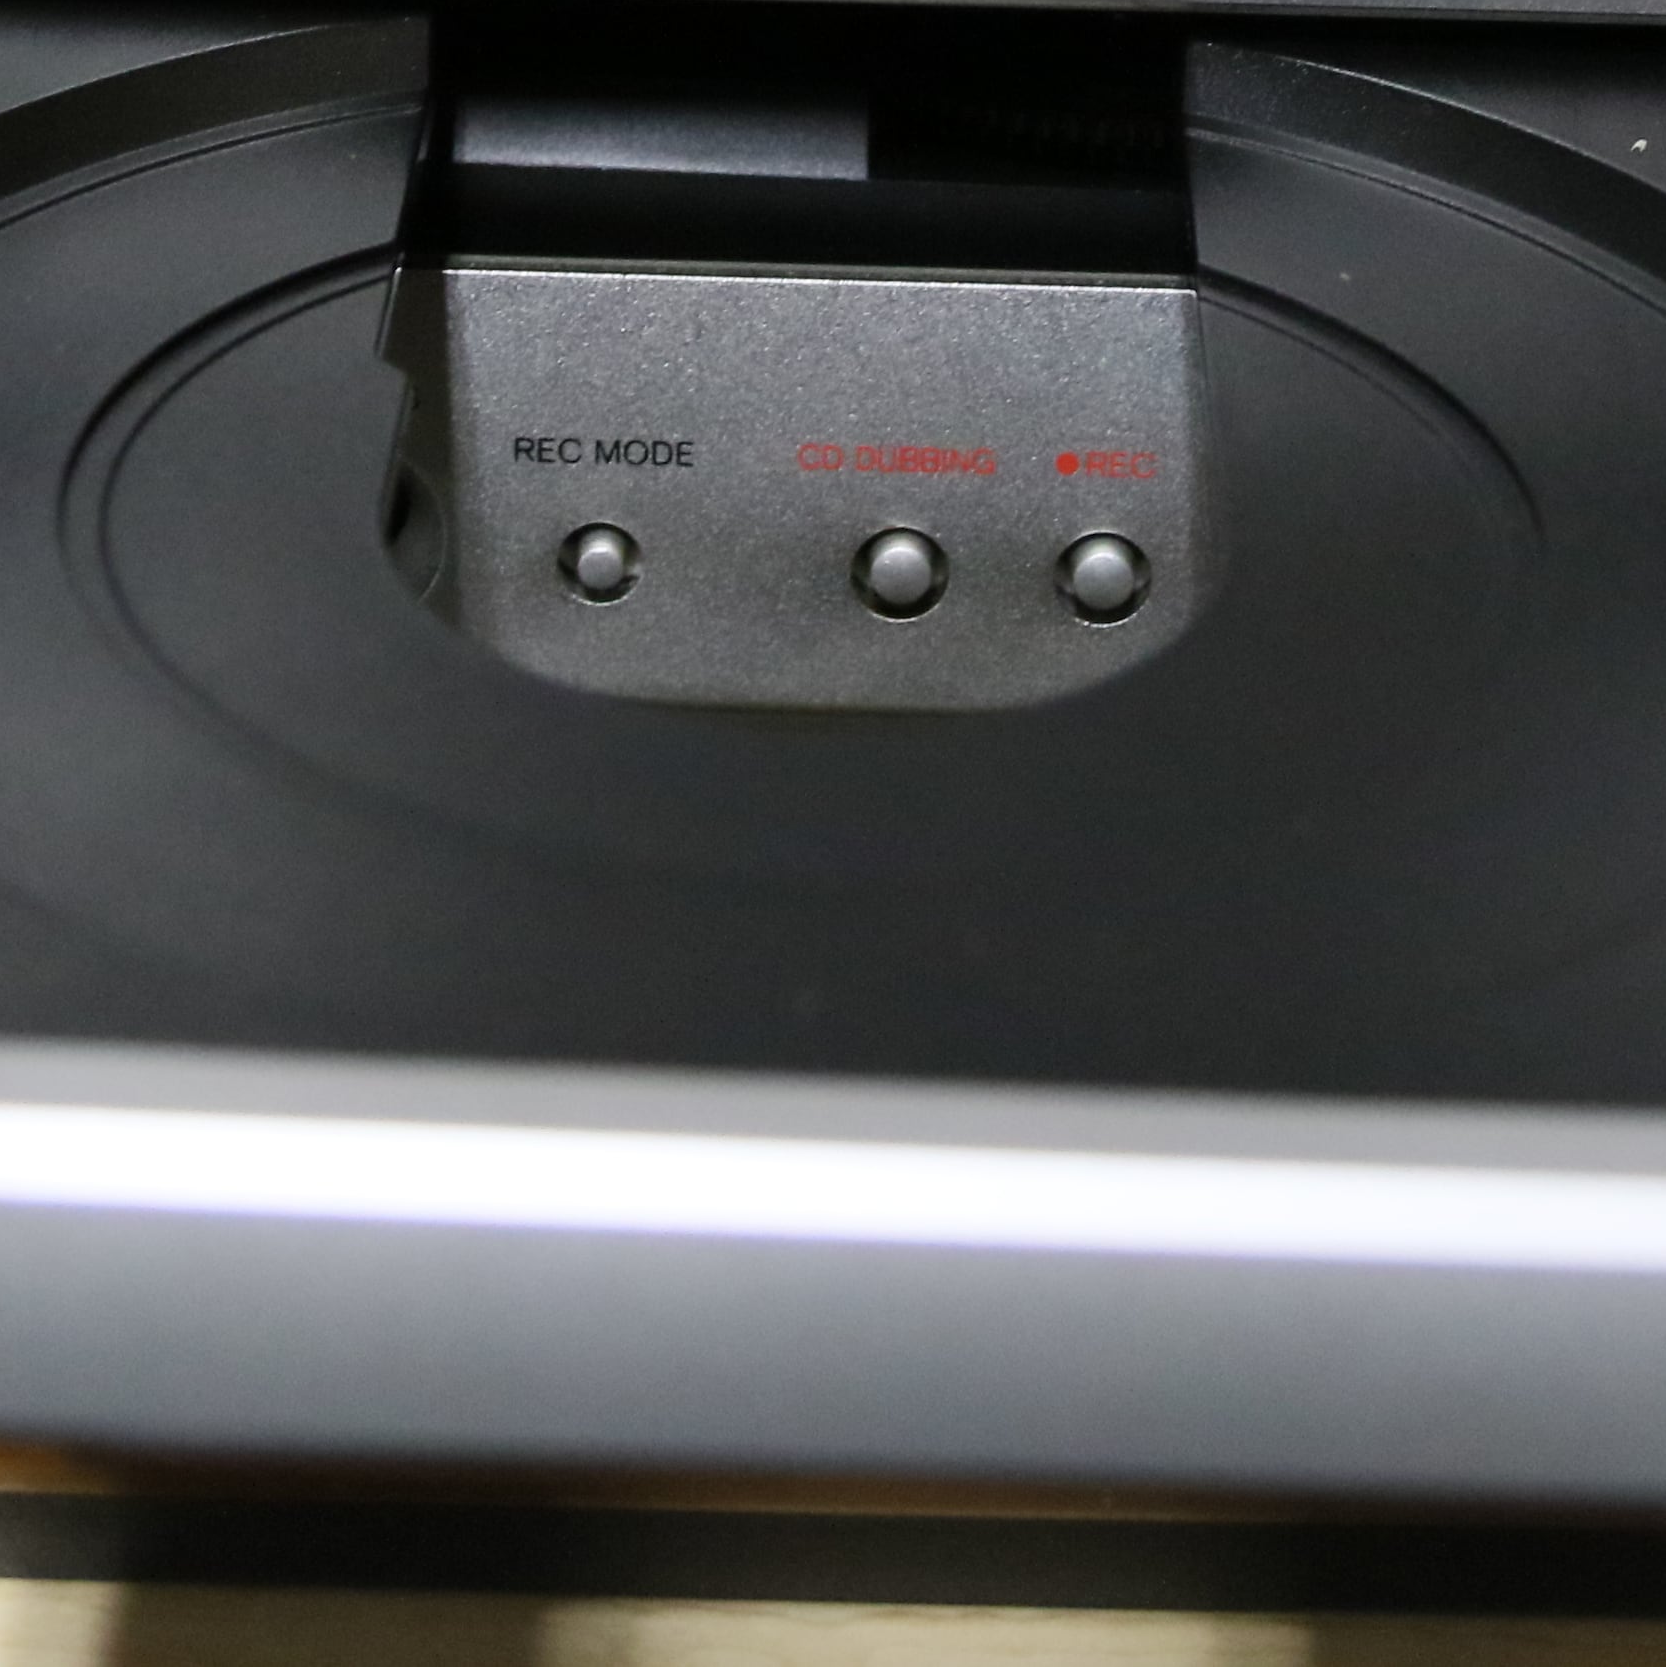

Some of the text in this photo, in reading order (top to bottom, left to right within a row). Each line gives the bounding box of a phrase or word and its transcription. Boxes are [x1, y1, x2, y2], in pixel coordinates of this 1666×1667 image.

[513, 436, 693, 467] REC MODE
[798, 443, 995, 475] CD DUBBING
[1084, 450, 1157, 479] REC
